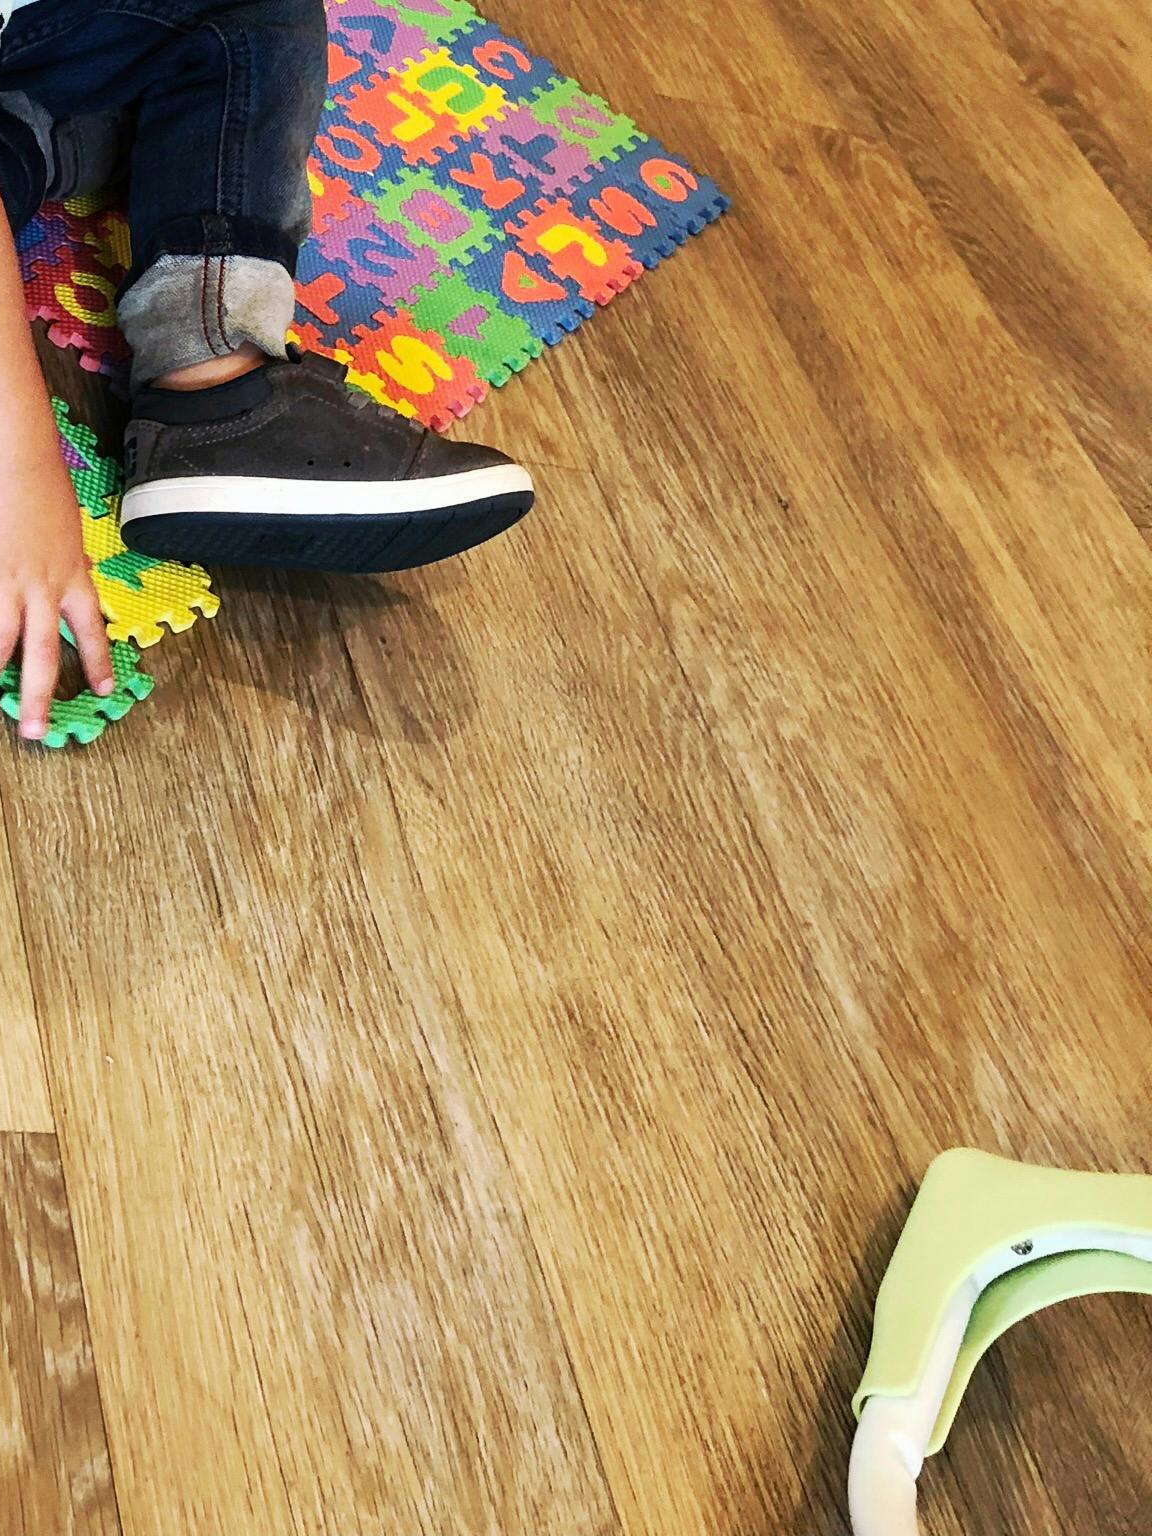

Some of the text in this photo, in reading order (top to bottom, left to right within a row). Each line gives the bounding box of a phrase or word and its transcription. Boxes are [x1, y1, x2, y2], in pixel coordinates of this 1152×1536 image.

[340, 14, 392, 55] V
[473, 40, 531, 79] 3
[418, 67, 485, 112] U
[386, 91, 434, 141] L
[317, 125, 382, 172] C
[507, 130, 568, 178] T
[450, 152, 524, 210] K
[537, 224, 607, 265] J
[503, 252, 566, 302] A
[376, 335, 453, 395] S
